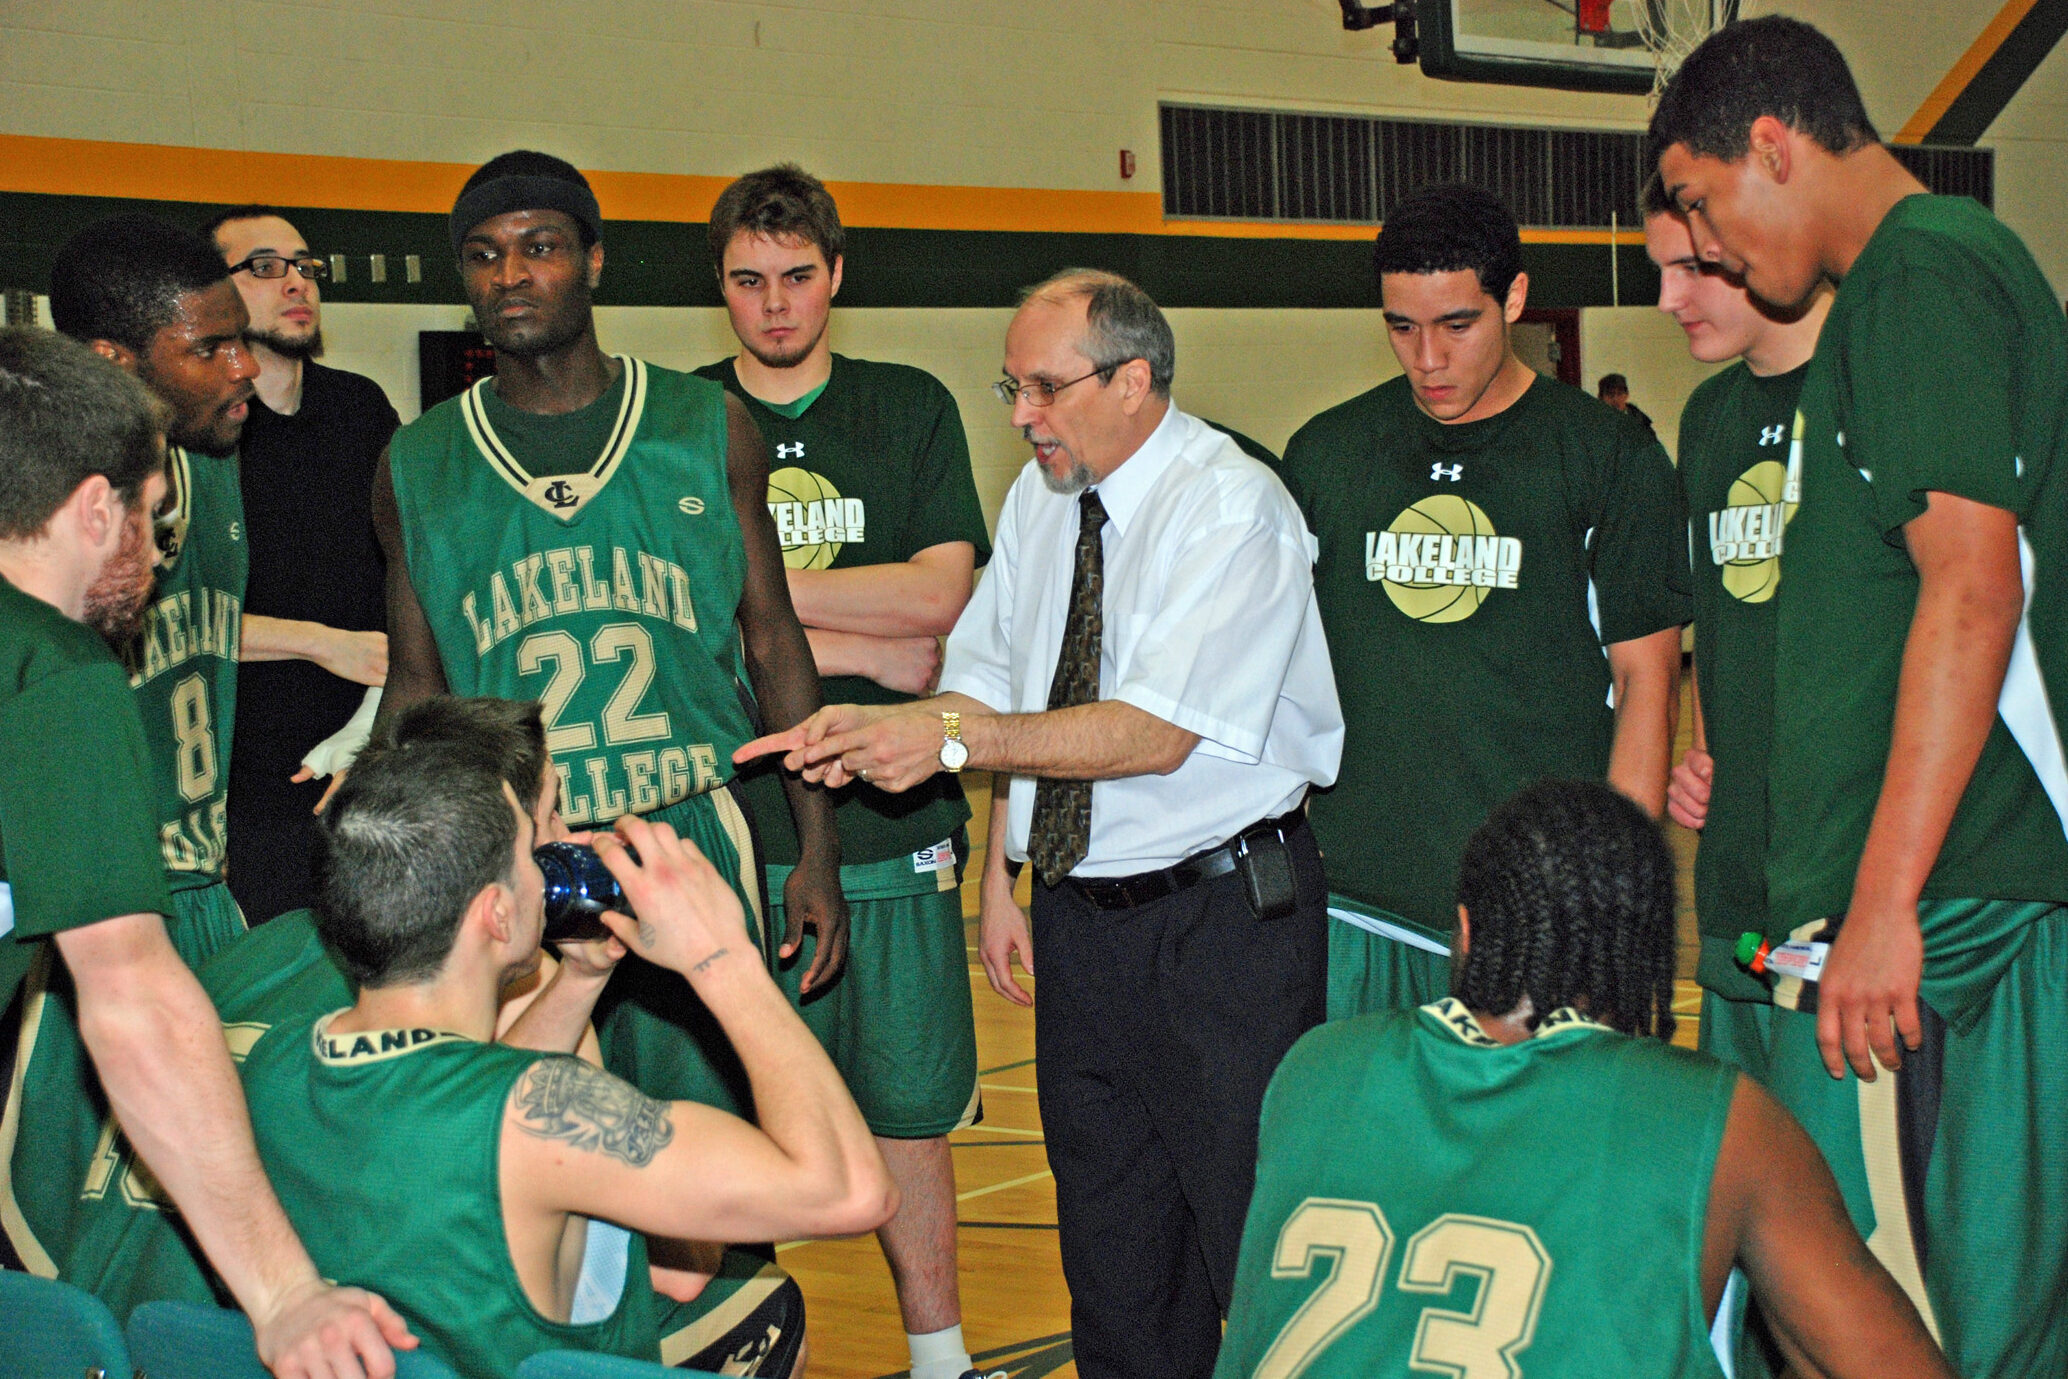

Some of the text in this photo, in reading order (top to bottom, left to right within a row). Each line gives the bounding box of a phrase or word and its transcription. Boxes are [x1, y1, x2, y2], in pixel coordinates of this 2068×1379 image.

[768, 498, 866, 532] ELAND
[778, 526, 865, 547] LLEGE
[1366, 531, 1523, 572] LAKELAND
[462, 545, 698, 657] LAKELAND
[1366, 563, 1519, 589] COLLEGE
[517, 621, 672, 754] 22
[171, 671, 218, 804] 8
[555, 743, 723, 827] LLEGE
[1251, 1196, 1553, 1379] 23
